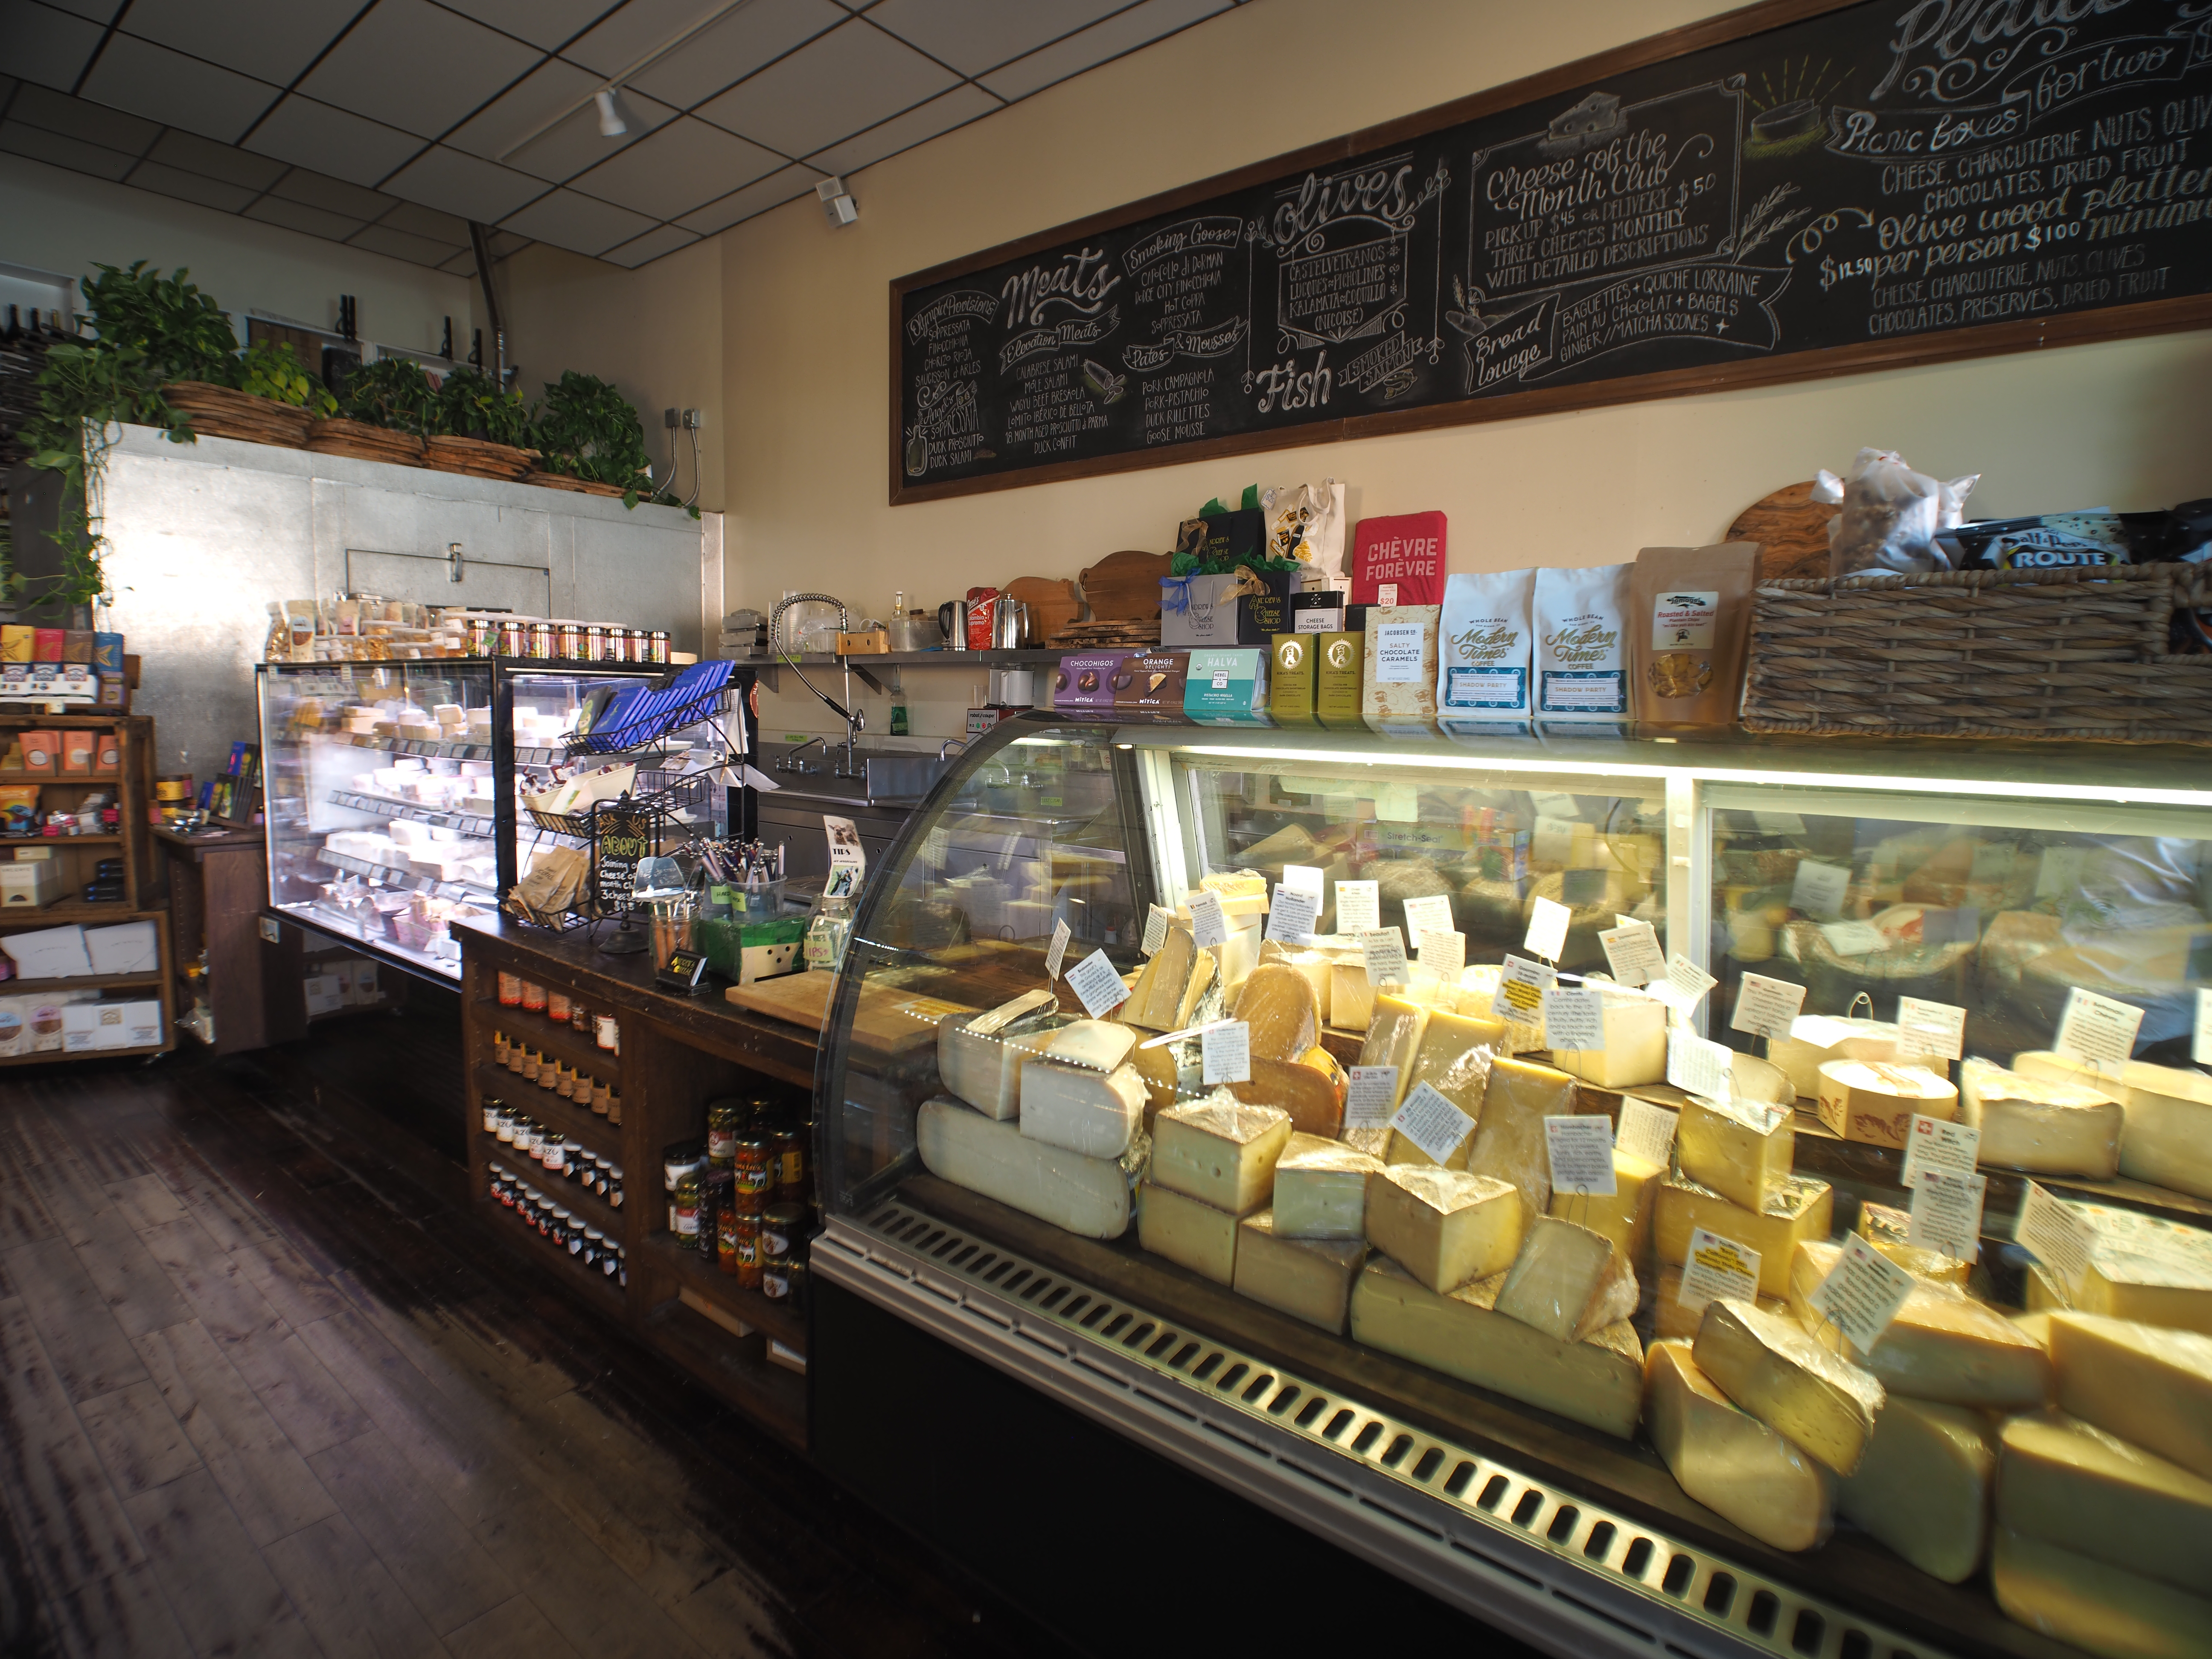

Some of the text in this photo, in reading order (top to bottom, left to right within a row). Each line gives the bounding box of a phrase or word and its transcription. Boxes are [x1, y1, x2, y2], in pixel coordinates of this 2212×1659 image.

[2036, 46, 2174, 110] for two
[1841, 112, 2022, 151] Picnic boxes
[1487, 128, 1666, 201] Cheese of the
[2052, 157, 2111, 189] DRIED
[2122, 137, 2192, 172] FRUIT
[1494, 151, 1669, 220] Month Club
[1879, 187, 2070, 252] Olive wood
[1130, 222, 1236, 268] Smoking Goose
[1492, 207, 1688, 268] THREE CHEESES MONTHLY
[1142, 252, 1222, 286] CAPOCOLLO di DORMAN
[1290, 245, 1385, 281] CASTELVETRANOS
[1486, 224, 1709, 288] WITH DETAILED DESCRIPTIONS
[1871, 248, 1919, 289] per
[1923, 230, 2021, 276] person
[2025, 222, 2080, 251] $100
[1002, 247, 1121, 329] Meats
[1135, 270, 1221, 304] DODGE CITY FINOCCHIONA
[1563, 269, 1761, 328] BAGUETTES QUICHE LORRAINE
[910, 295, 995, 337] Olympia Provisions
[929, 320, 970, 341] SOPPRESSATA
[1562, 293, 1738, 343] PAIN AU CHOCOLAT BAGELS
[929, 335, 968, 355] FINOCCHIONA
[1007, 322, 1101, 362] Elevation Meats
[1476, 302, 1546, 362] Bread
[925, 348, 972, 370] CHORIZO RIOJA
[1132, 330, 1239, 367] Pates & Mousses
[1352, 338, 1400, 376] SMOKED
[1016, 354, 1078, 380] CALABRESE SALAMI
[1143, 368, 1214, 395] PORK CAMPAGNOLA
[1256, 350, 1331, 412] Fish
[1366, 349, 1411, 385] SALMON
[1010, 387, 1085, 412] WAGYU BEEF BRESAOLA
[1145, 387, 1208, 410] PORK-PISTACHIO
[931, 399, 978, 439] SOPPRESSATA
[1005, 415, 1108, 444] 18 MONTH AGED PROSCIUTTO di PARMA
[1147, 422, 1205, 444] GOOSE MOUSSE
[929, 434, 984, 455] DUCK PROSCIUTTO
[1266, 493, 1275, 504] $25
[1368, 536, 1438, 562] CHÈVRE
[2016, 552, 2107, 568] ROUTE
[1365, 559, 1436, 581] FORÈVRE
[1451, 626, 1519, 647] Modern
[1545, 624, 1617, 648] Modern
[1208, 658, 1237, 667] HALVA
[1459, 644, 1507, 660] Times
[1554, 645, 1607, 662] Times
[599, 813, 647, 830] ASK US
[601, 835, 648, 858] ABOUT
[1387, 832, 1441, 844] Stretch-Seal
[600, 855, 629, 873] Joining
[600, 870, 626, 880] Cheese
